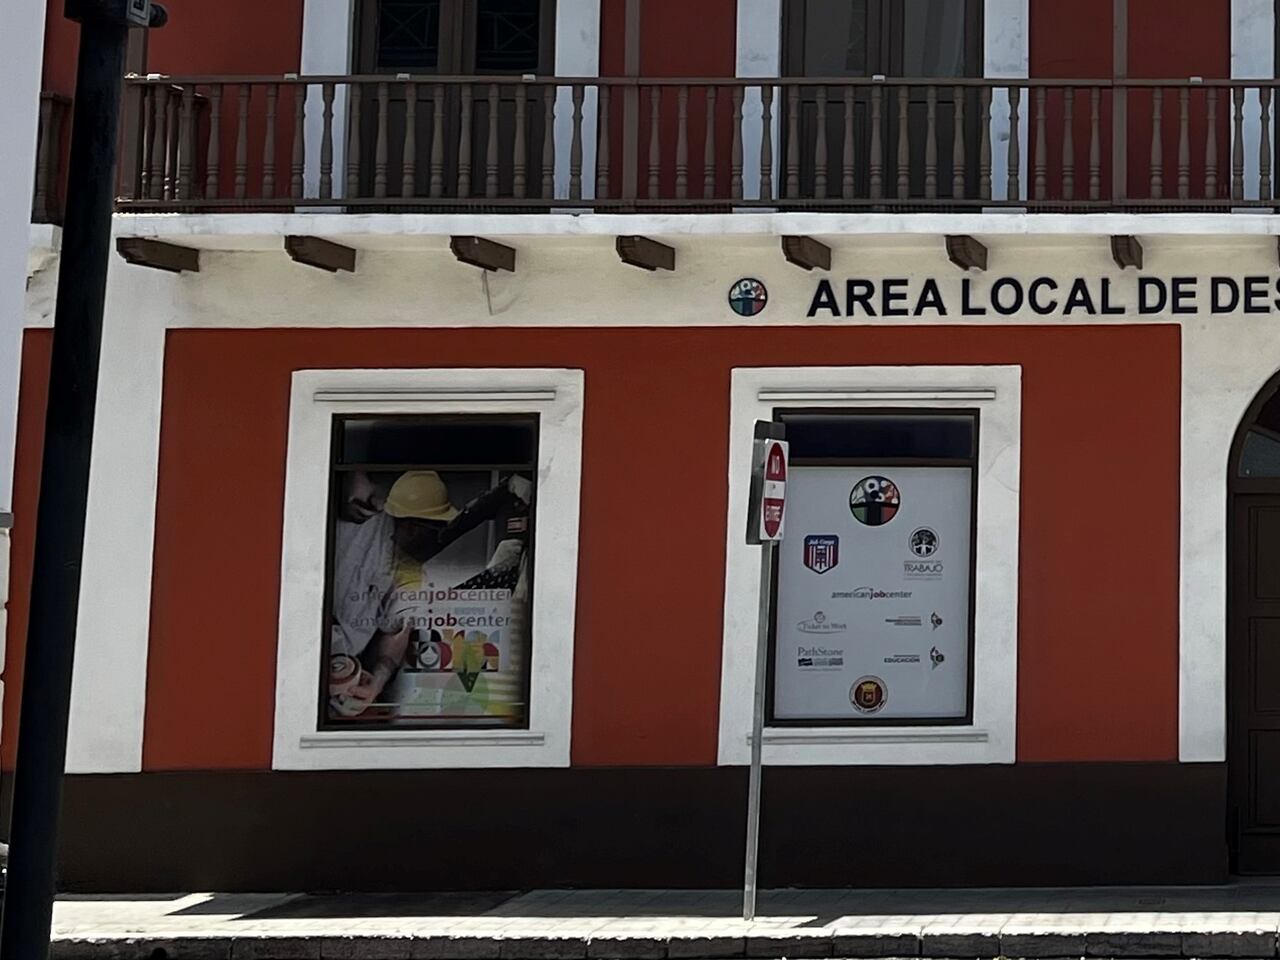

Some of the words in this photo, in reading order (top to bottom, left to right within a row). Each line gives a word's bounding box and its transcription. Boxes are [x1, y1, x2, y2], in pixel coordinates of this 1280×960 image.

[804, 278, 948, 318] AREA
[961, 276, 1125, 317] LOCAL
[1138, 276, 1199, 315] DE
[903, 563, 944, 573] TRABAJO
[350, 583, 511, 604] ameicanjobcenter
[831, 587, 913, 601] americanjobcenter
[350, 609, 512, 630] amanjobcenter
[797, 646, 845, 657] PathStone
